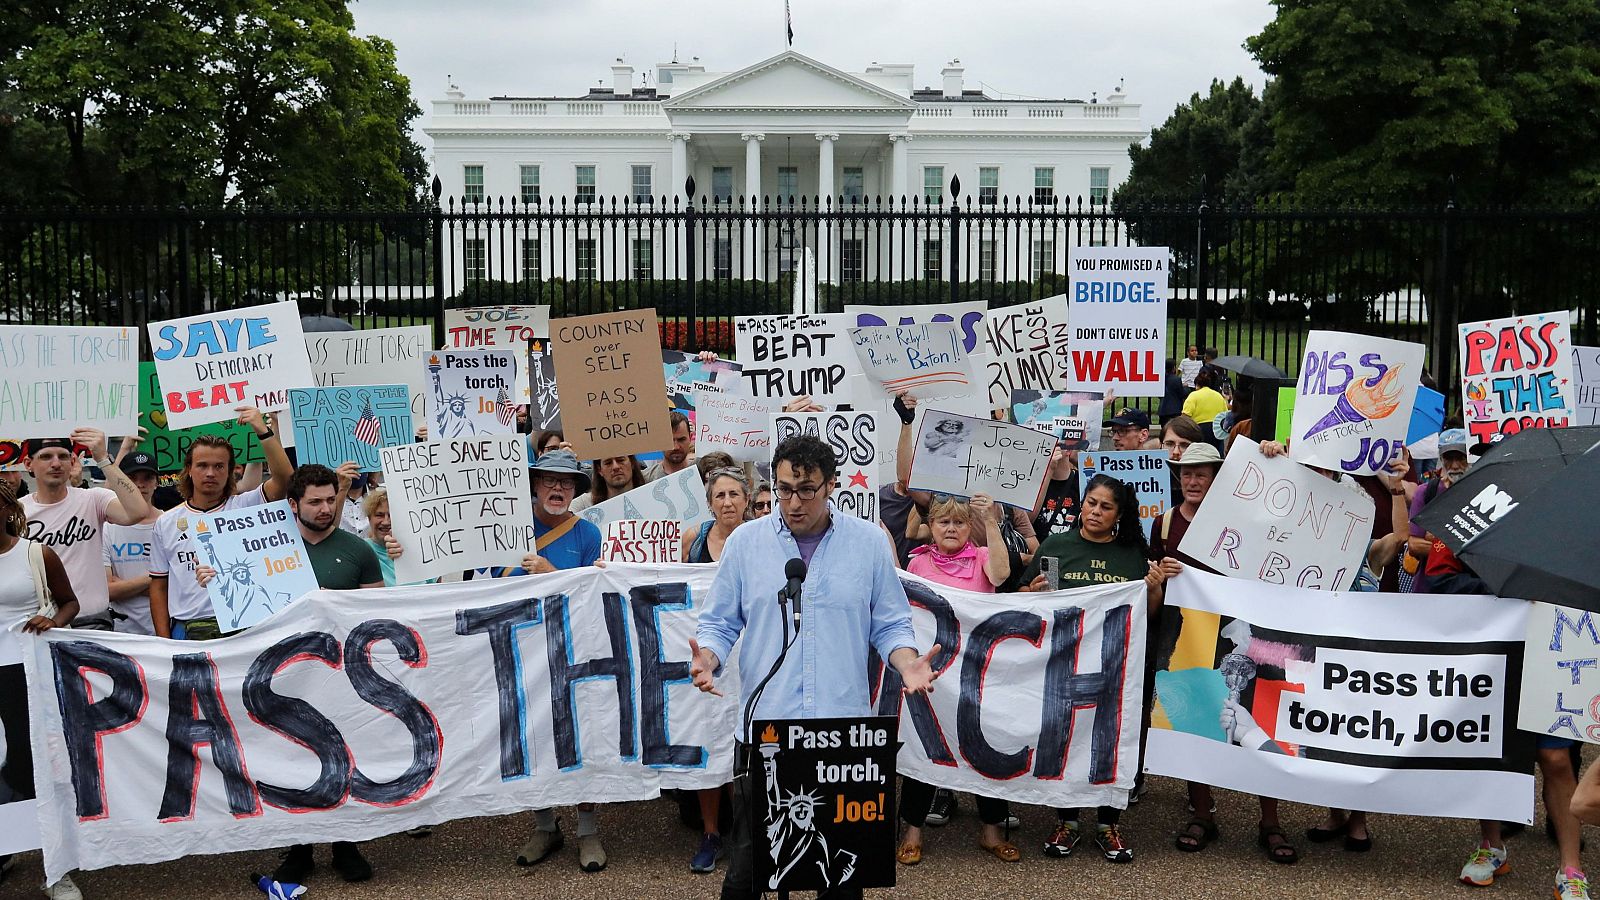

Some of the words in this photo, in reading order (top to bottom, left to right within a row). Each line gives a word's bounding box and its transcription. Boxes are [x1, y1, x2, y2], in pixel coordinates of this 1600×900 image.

[1076, 259, 1096, 271] YOU
[1099, 259, 1153, 271] PROMISED
[1156, 259, 1163, 271] A
[1075, 281, 1161, 303] BRIDGE.
[464, 306, 530, 322] JOE,
[153, 317, 278, 361] SAVE
[449, 326, 497, 348] TIME
[504, 325, 535, 343] TO
[558, 318, 646, 345] COUNTRY
[986, 314, 1025, 357] AKE
[1076, 328, 1105, 340] DON'T
[1109, 328, 1132, 340] GIVE
[1135, 328, 1149, 340] US
[1151, 328, 1159, 340] A
[34, 334, 57, 368] THE
[342, 337, 372, 366] THE
[378, 334, 425, 364] TORCH
[593, 342, 621, 354] over
[753, 333, 836, 362] BEAT
[1464, 321, 1560, 377] PASS
[195, 353, 275, 382] DEMOCRACY
[446, 355, 480, 369] Pass
[484, 354, 508, 368] the
[584, 353, 632, 375] SELF
[1072, 350, 1160, 382] WALL
[1301, 351, 1387, 397] PASS
[465, 374, 509, 391] torch,
[676, 384, 692, 393] THE
[694, 383, 720, 393] TORCH
[742, 364, 846, 397] TRUMP
[986, 350, 1055, 405] RUMP
[0, 378, 42, 426] AVE
[75, 379, 137, 423] PLANET
[166, 380, 250, 414] BEAT
[290, 390, 372, 418] PASS
[373, 388, 407, 399] THE
[586, 387, 638, 408] PASS
[1492, 370, 1566, 414] THE
[605, 409, 629, 421] the
[1036, 423, 1053, 431] THE
[1054, 419, 1083, 427] TORCH
[584, 421, 650, 444] TORCH
[1064, 431, 1082, 439] JOE!
[1311, 432, 1330, 446] THE
[1333, 420, 1374, 439] TORCH
[383, 443, 440, 475] PLEASE
[451, 441, 494, 464] SAVE
[500, 440, 521, 462] US
[1100, 456, 1134, 471] Pass
[1138, 455, 1163, 469] the
[403, 472, 447, 501] FROM
[458, 467, 521, 489] TRUMP
[408, 500, 470, 534] DON'T
[480, 498, 518, 517] ACT
[1139, 500, 1164, 519] oe!
[1233, 461, 1368, 552] DON'T
[214, 517, 255, 533] Pass
[258, 508, 287, 525] the
[607, 520, 637, 541] LET
[242, 530, 295, 553] torch,
[420, 528, 464, 564] LIKE
[474, 523, 535, 552] TRUMP
[1266, 526, 1293, 543] BE
[263, 550, 303, 577] Joe!
[602, 540, 647, 563] PASS
[648, 539, 678, 563] THE
[1090, 559, 1106, 569] IM
[1063, 572, 1091, 581] SHA
[1323, 662, 1418, 697] Pass
[1427, 667, 1493, 698] the
[50, 618, 444, 823] PASS
[456, 582, 711, 782] THE
[868, 577, 1132, 786] RCH
[788, 725, 842, 749] Pass
[848, 723, 887, 747] the
[1288, 700, 1405, 747] torch,
[1414, 713, 1490, 744] Joe!
[815, 757, 886, 785] torch,
[833, 792, 885, 823] Joe!
